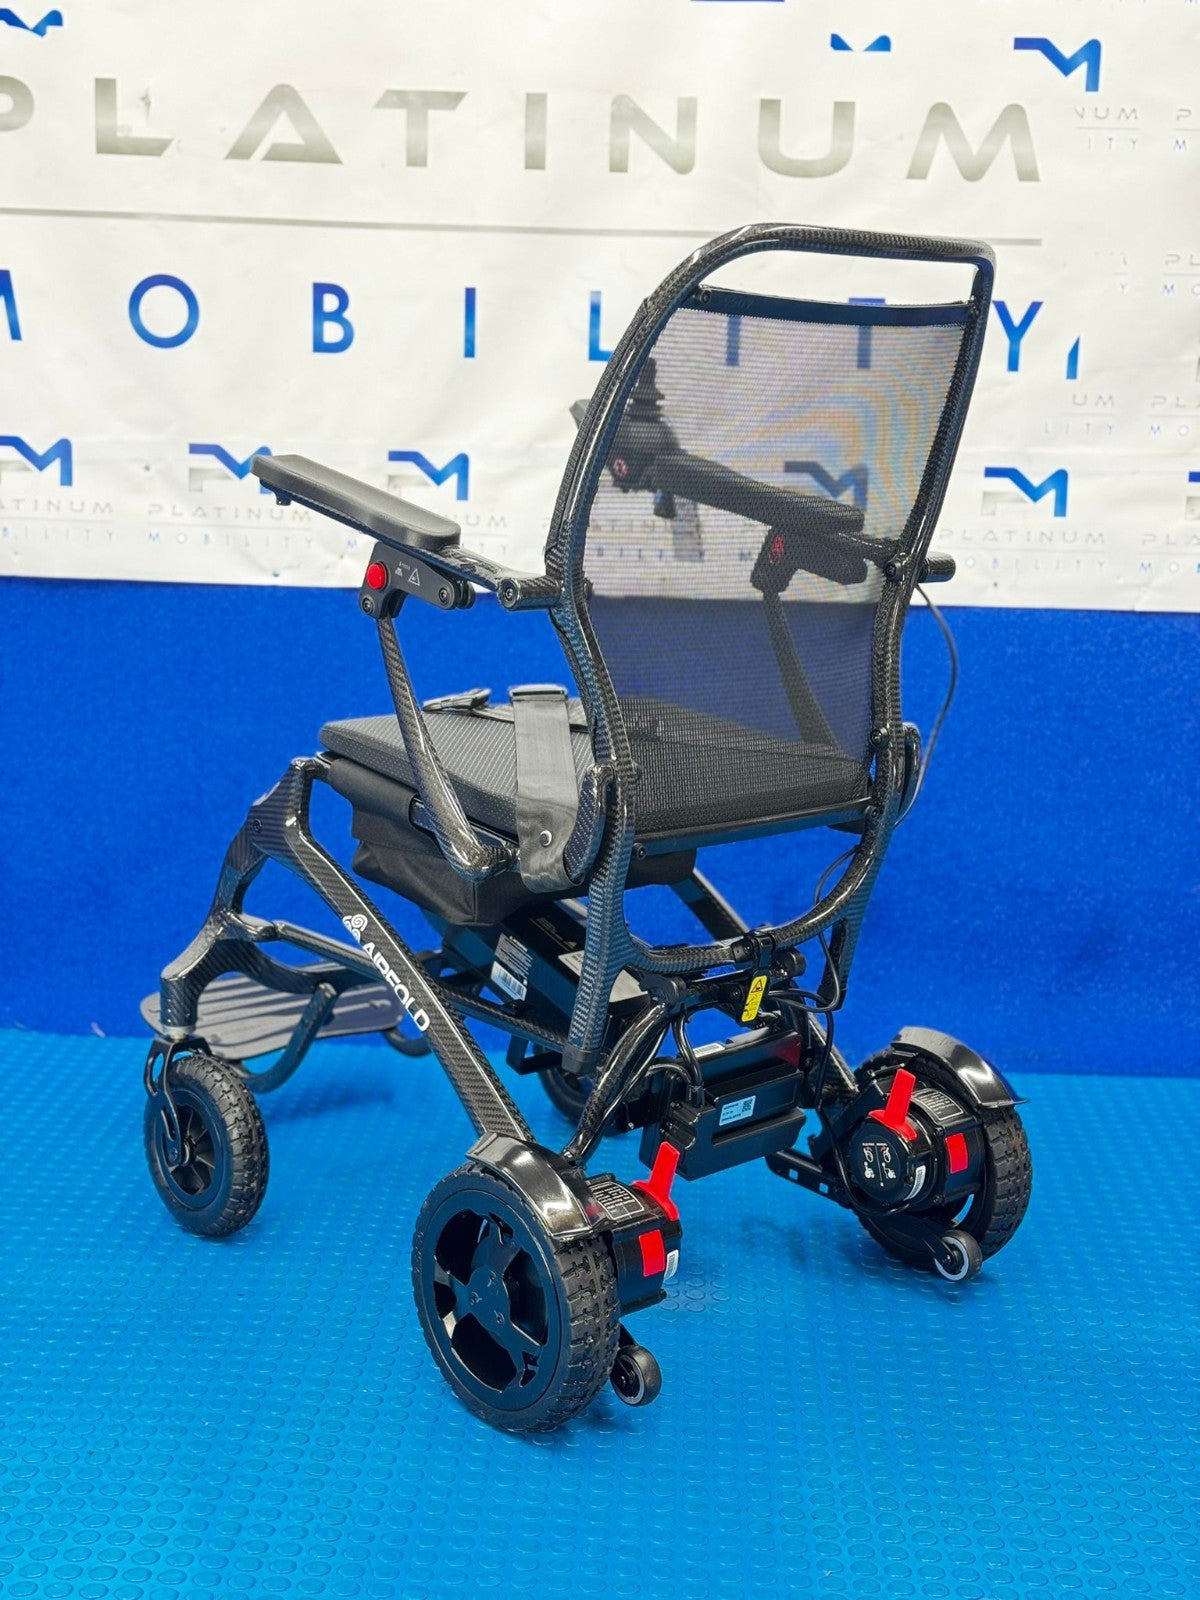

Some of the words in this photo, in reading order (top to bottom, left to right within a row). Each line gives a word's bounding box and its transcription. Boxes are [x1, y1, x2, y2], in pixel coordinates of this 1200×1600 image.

[148, 503, 313, 522] PLATINUM
[938, 529, 1106, 545] PLATINUM
[965, 557, 1107, 572] OBILITY
[362, 941, 431, 1032] AIRFOLD
